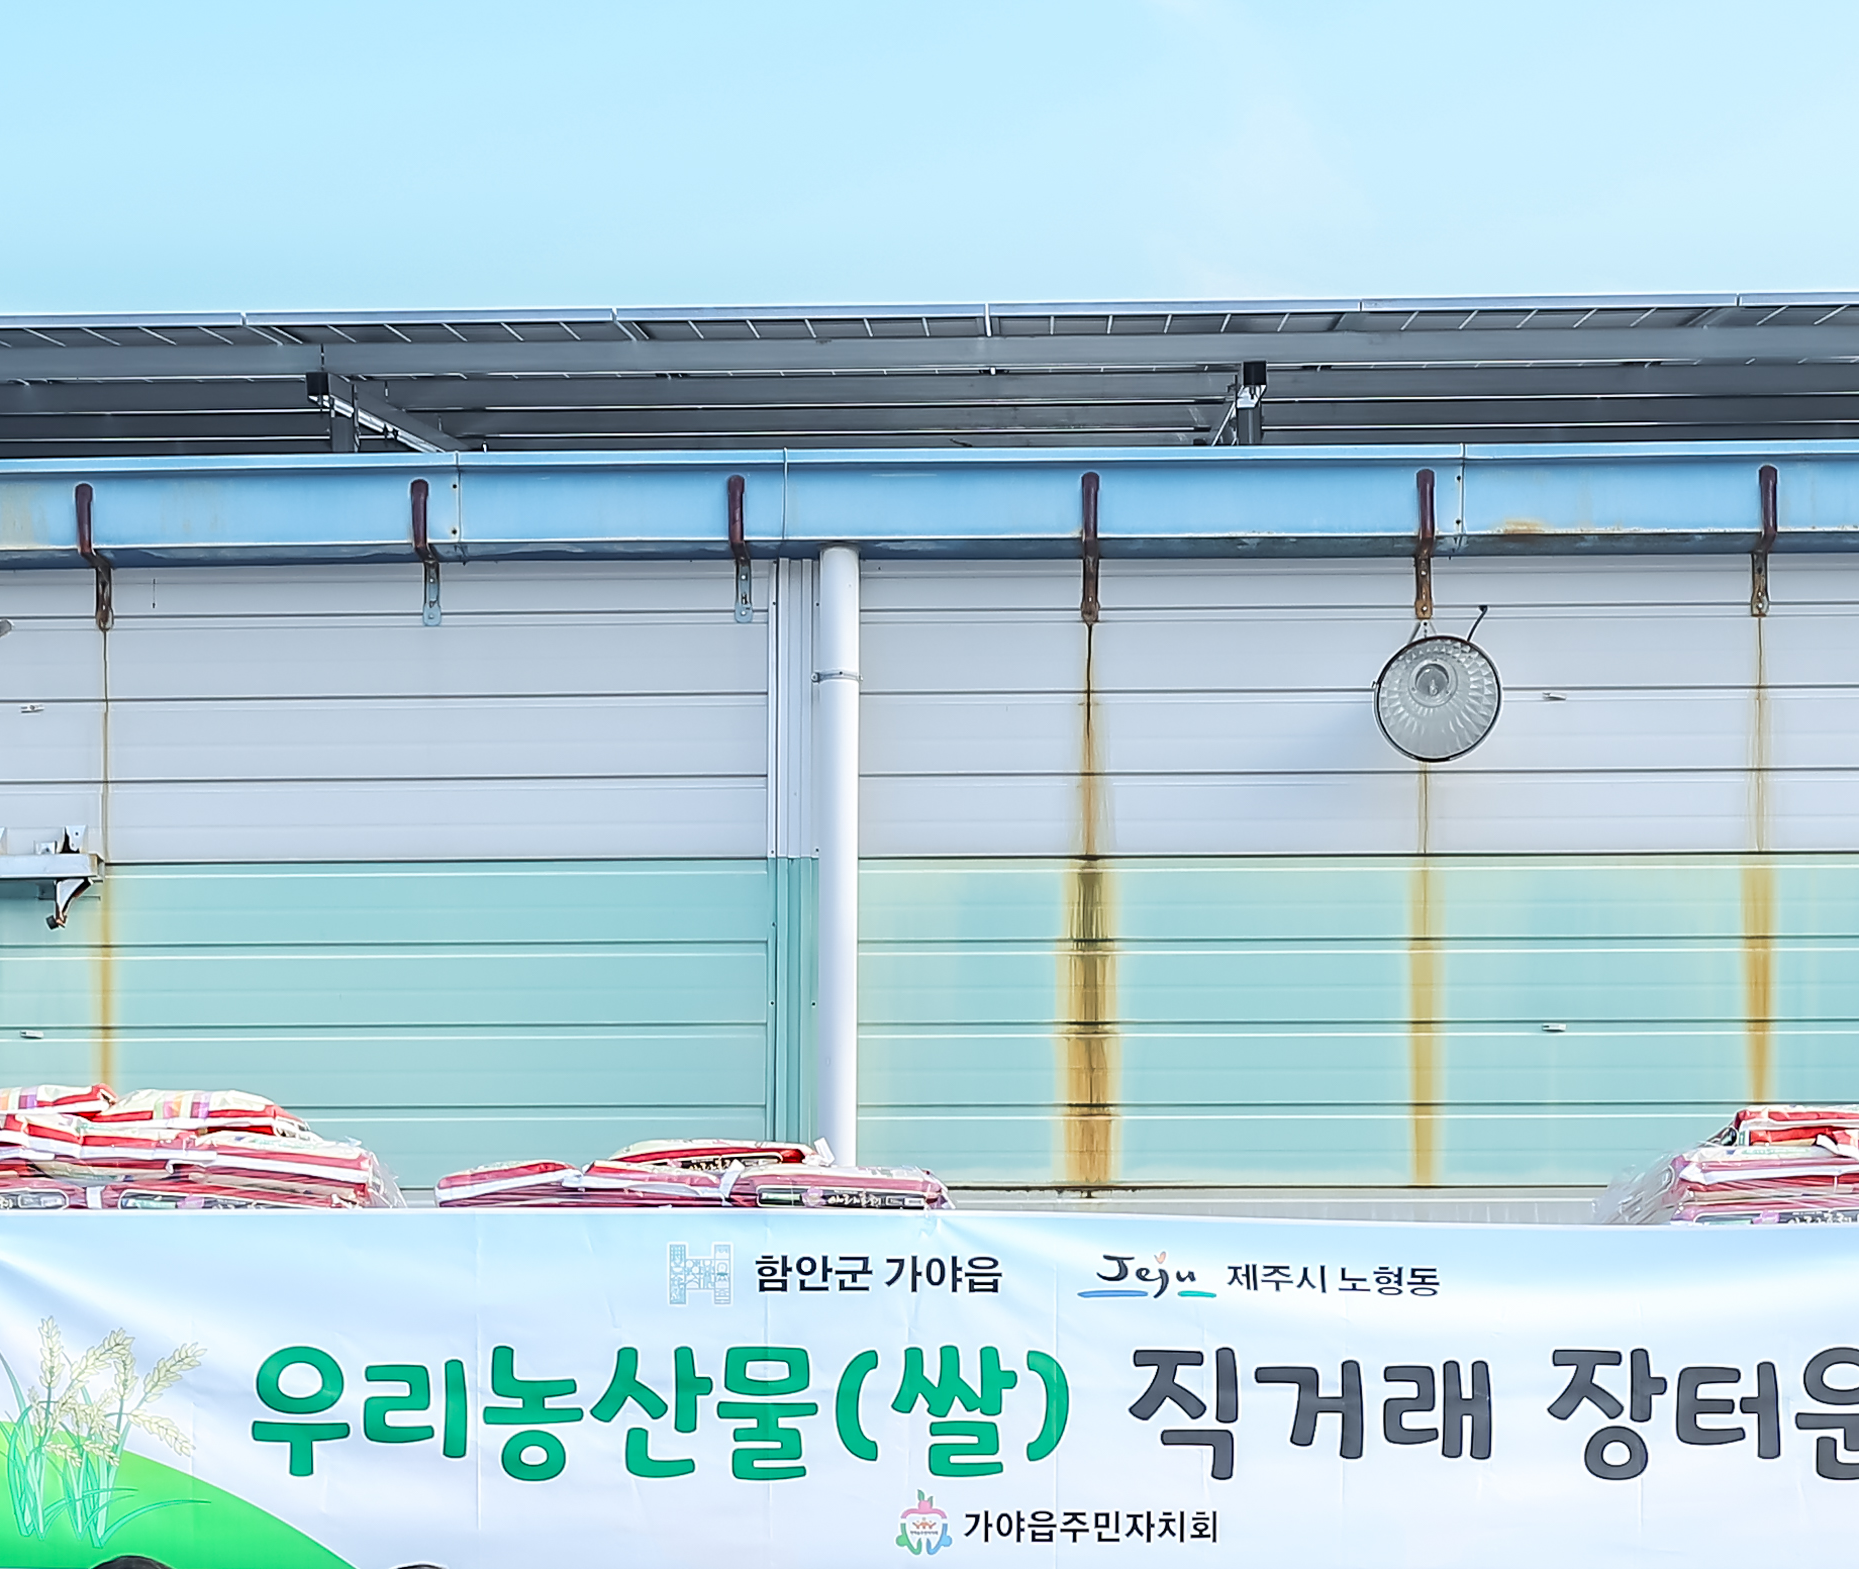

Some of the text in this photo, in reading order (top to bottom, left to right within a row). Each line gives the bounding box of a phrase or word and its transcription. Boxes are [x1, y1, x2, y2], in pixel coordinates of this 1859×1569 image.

[755, 1255, 1002, 1293] 함안군 가야읍
[1095, 1254, 1197, 1299] Jeju
[1227, 1264, 1440, 1296] 제주시 노형동
[249, 1343, 1072, 1484] 우리농산물(쌀)
[1126, 1345, 1494, 1483] 직거래
[964, 1510, 1218, 1543] 가야읍주민자치회
